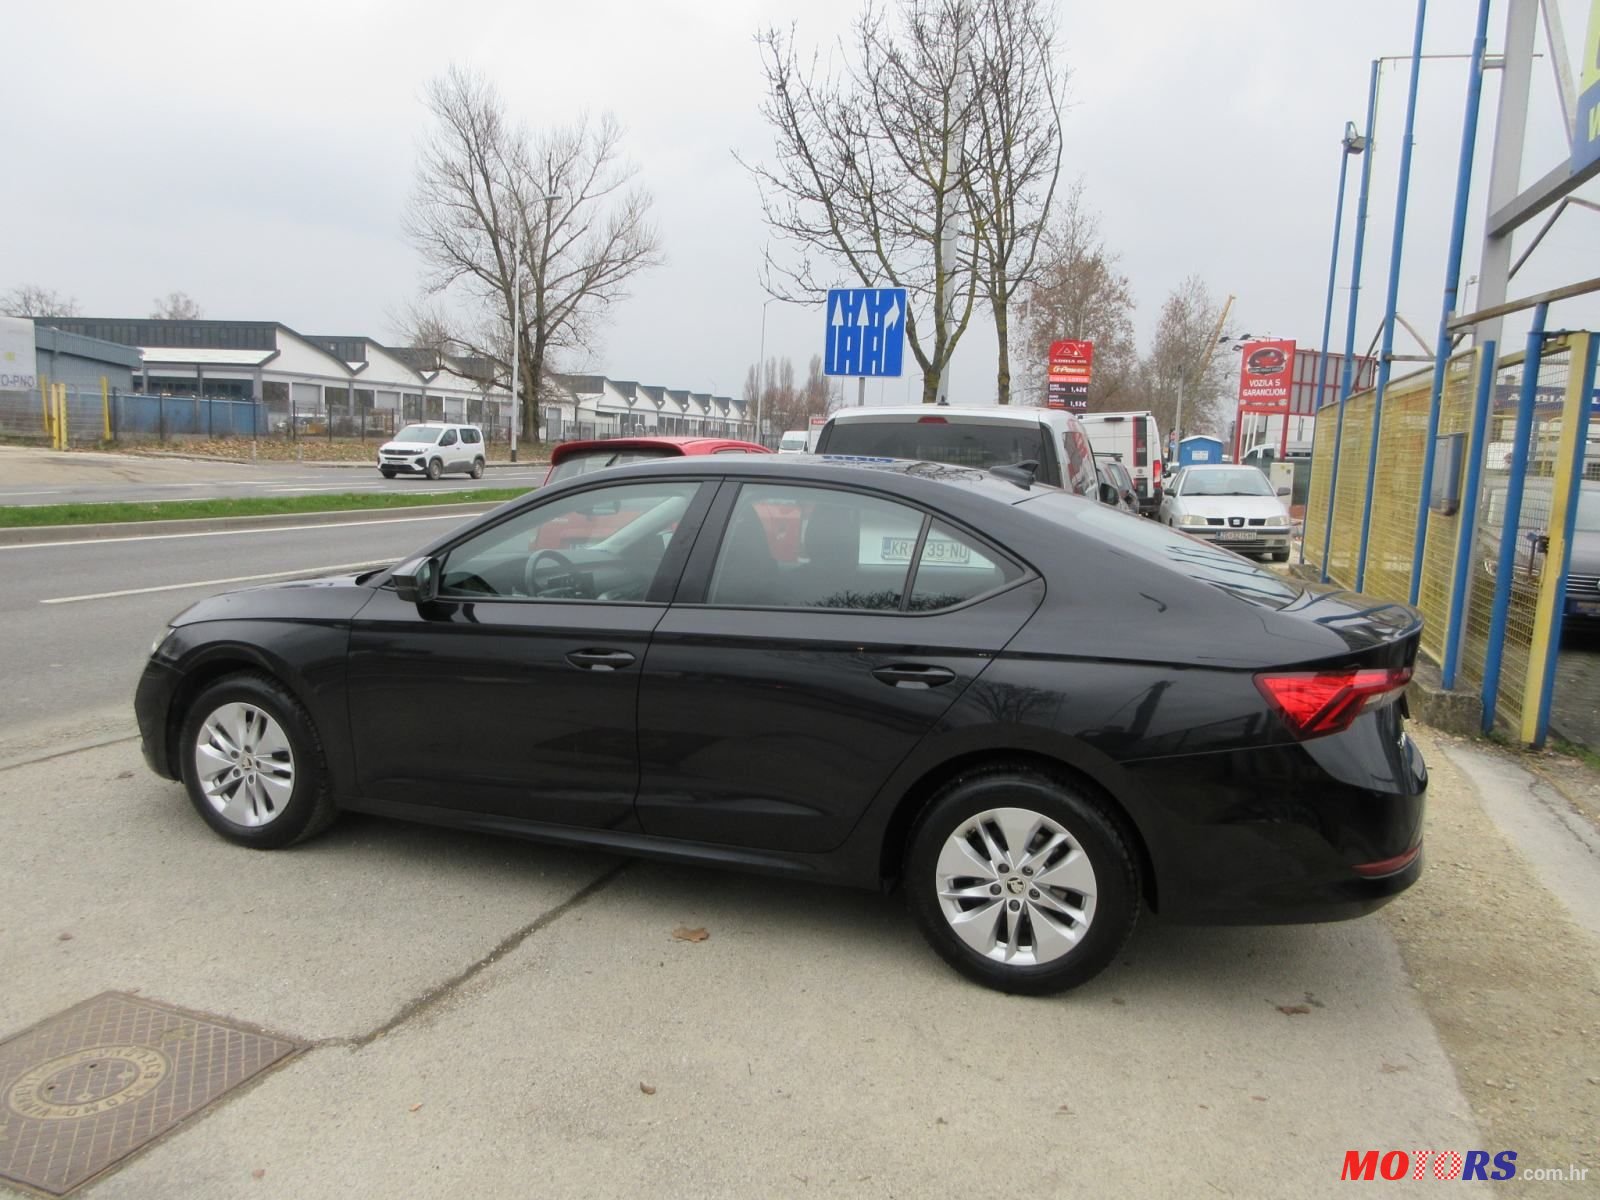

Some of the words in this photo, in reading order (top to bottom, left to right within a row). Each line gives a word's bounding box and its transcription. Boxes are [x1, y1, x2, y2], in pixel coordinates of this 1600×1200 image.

[1249, 379, 1274, 388] VOZILA
[1274, 378, 1281, 387] S
[1242, 388, 1287, 397] GARANCIJOM
[891, 541, 908, 555] KR
